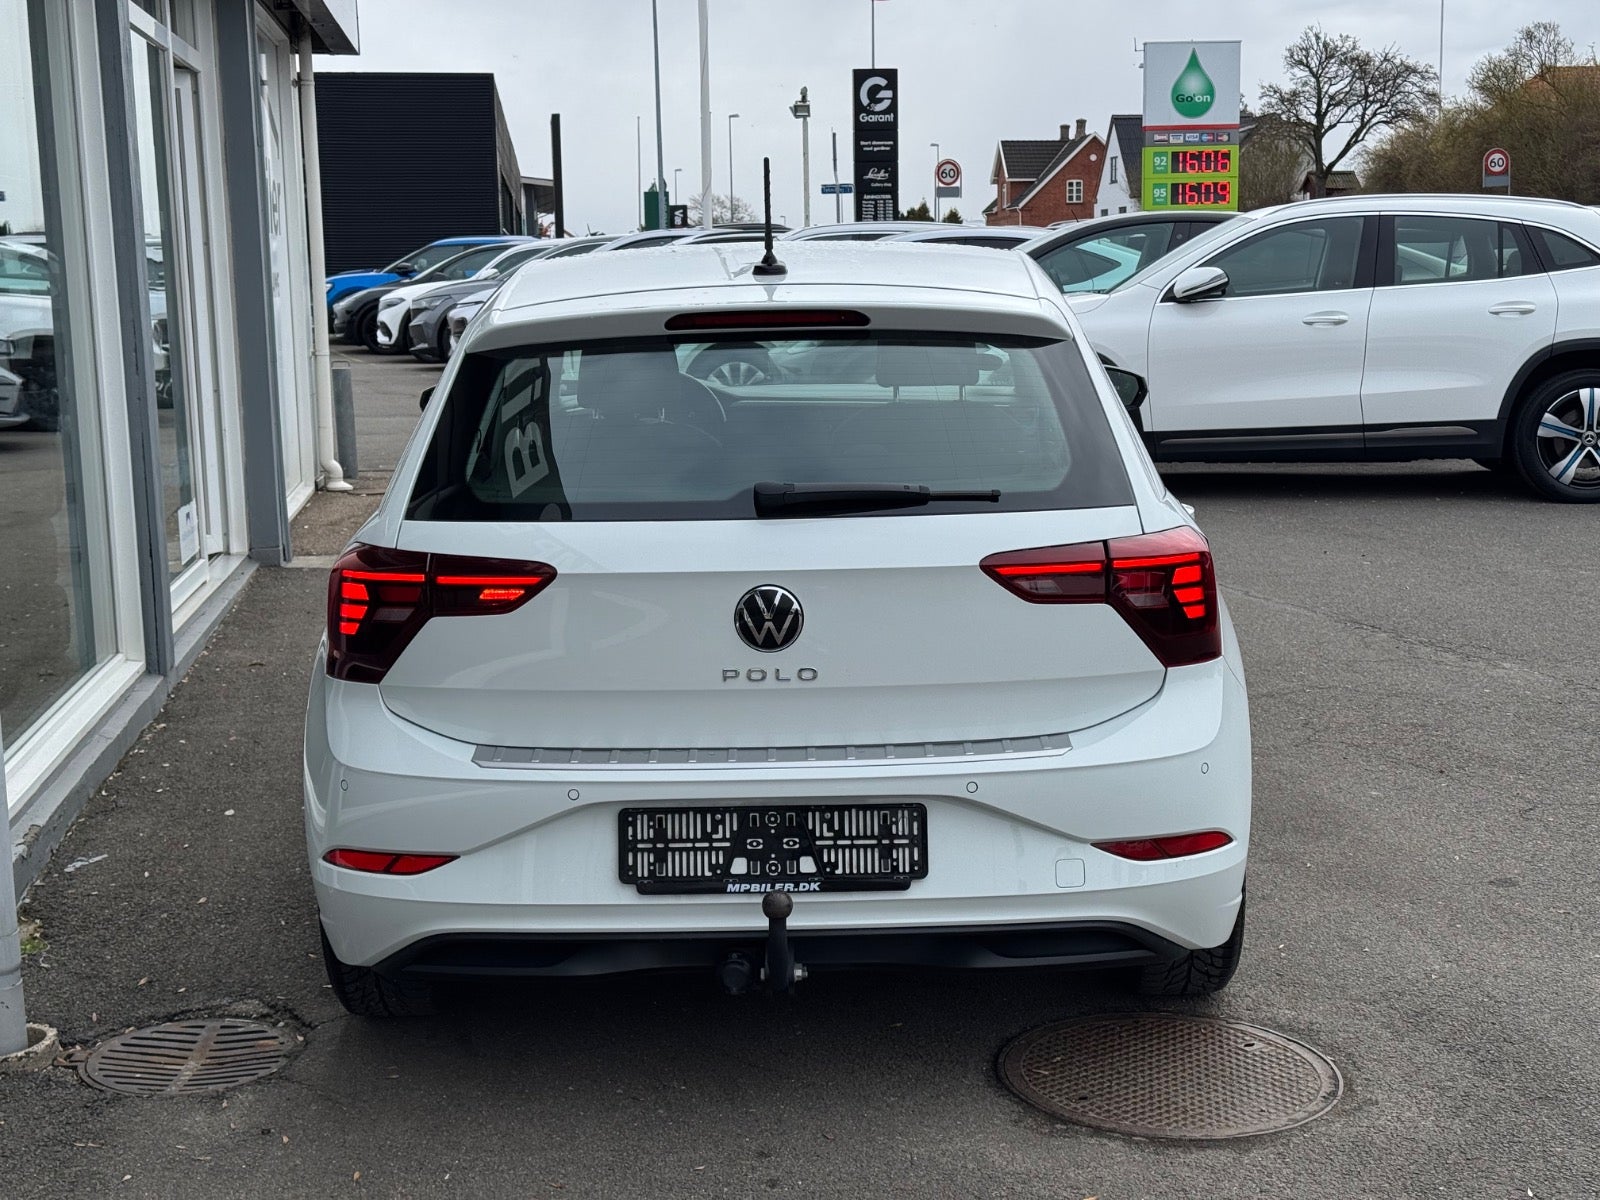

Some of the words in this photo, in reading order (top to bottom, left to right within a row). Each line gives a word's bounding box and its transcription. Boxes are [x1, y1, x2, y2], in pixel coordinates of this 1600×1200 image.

[1175, 93, 1211, 103] Go'on
[859, 113, 894, 122] Garant
[1154, 156, 1167, 166] 92
[1178, 149, 1231, 173] 16.06
[1490, 158, 1504, 168] 60
[941, 169, 955, 179] 60
[1153, 188, 1166, 198] 95
[1178, 181, 1230, 206] 16.09
[722, 667, 819, 682] POLO
[726, 882, 821, 892] MPBILER.DK
